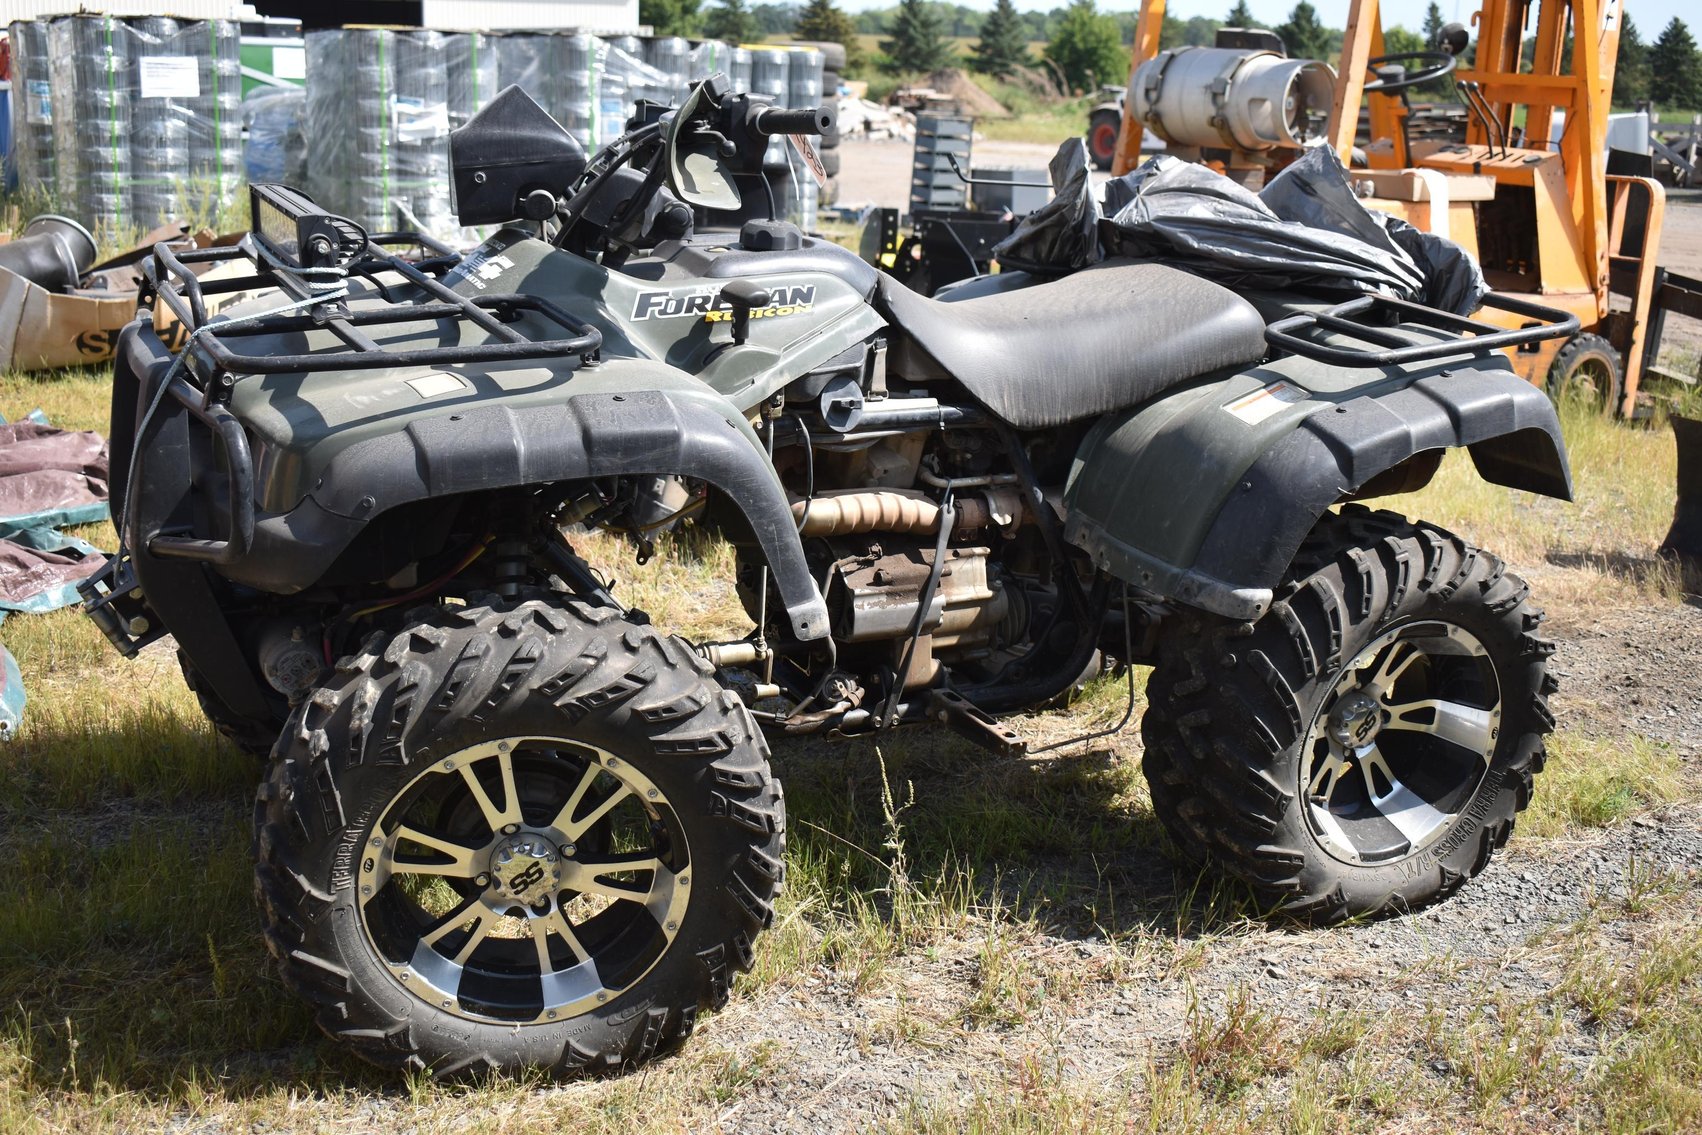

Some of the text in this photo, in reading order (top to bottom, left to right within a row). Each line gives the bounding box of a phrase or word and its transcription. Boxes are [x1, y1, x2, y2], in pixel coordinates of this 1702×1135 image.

[630, 284, 816, 321] FOREAN
[1355, 710, 1377, 742] SS
[1431, 817, 1477, 862] CROSS
[509, 861, 545, 895] SS
[552, 1032, 562, 1040] IN
[566, 1023, 592, 1037] MADE
